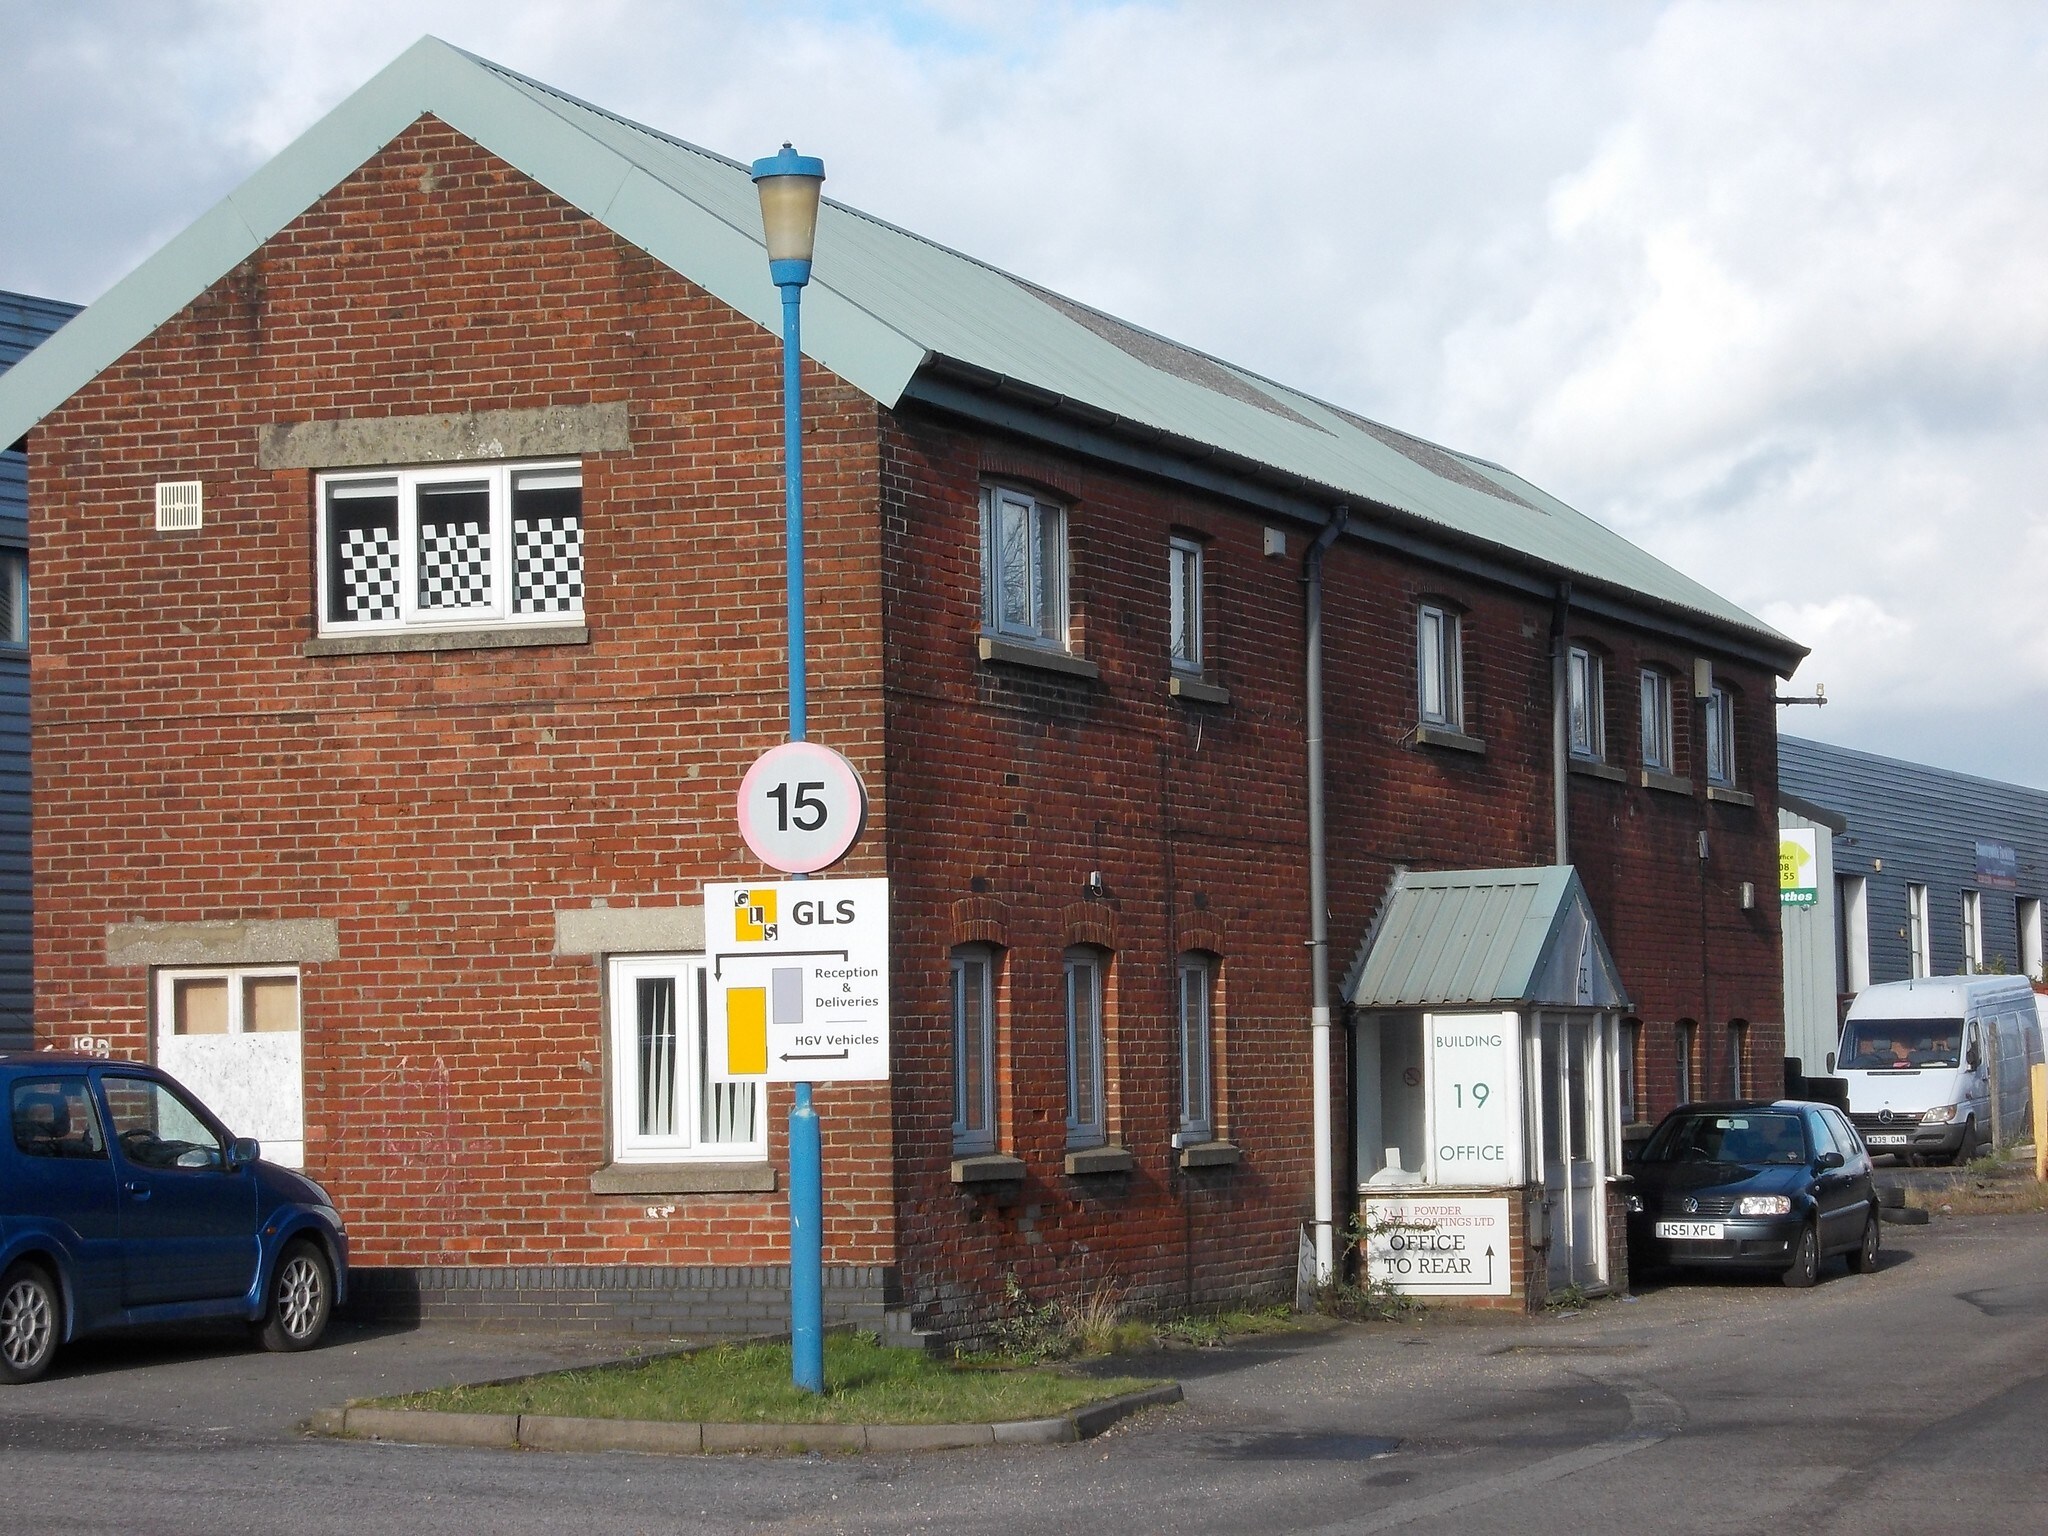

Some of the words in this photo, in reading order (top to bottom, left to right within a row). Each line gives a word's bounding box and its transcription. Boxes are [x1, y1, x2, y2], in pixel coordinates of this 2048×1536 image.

[766, 781, 828, 831] 15
[792, 900, 856, 926] GLS
[815, 967, 879, 980] Reception
[842, 982, 852, 993] &
[815, 996, 879, 1008] Deliveries
[795, 1035, 822, 1046] HGV
[826, 1034, 879, 1046] Vehicles
[1436, 1034, 1502, 1048] BUILDING
[1453, 1082, 1490, 1109] 19
[1439, 1145, 1505, 1161] OFFICE
[1414, 1206, 1462, 1216] POWDER
[1414, 1217, 1472, 1228] COATINGS
[1474, 1217, 1495, 1227] LTD
[1663, 1224, 1690, 1236] HS51
[1692, 1224, 1716, 1236] XPC
[1390, 1234, 1466, 1251] OFFICE
[1383, 1258, 1412, 1274] TO
[1418, 1258, 1472, 1274] REAR
